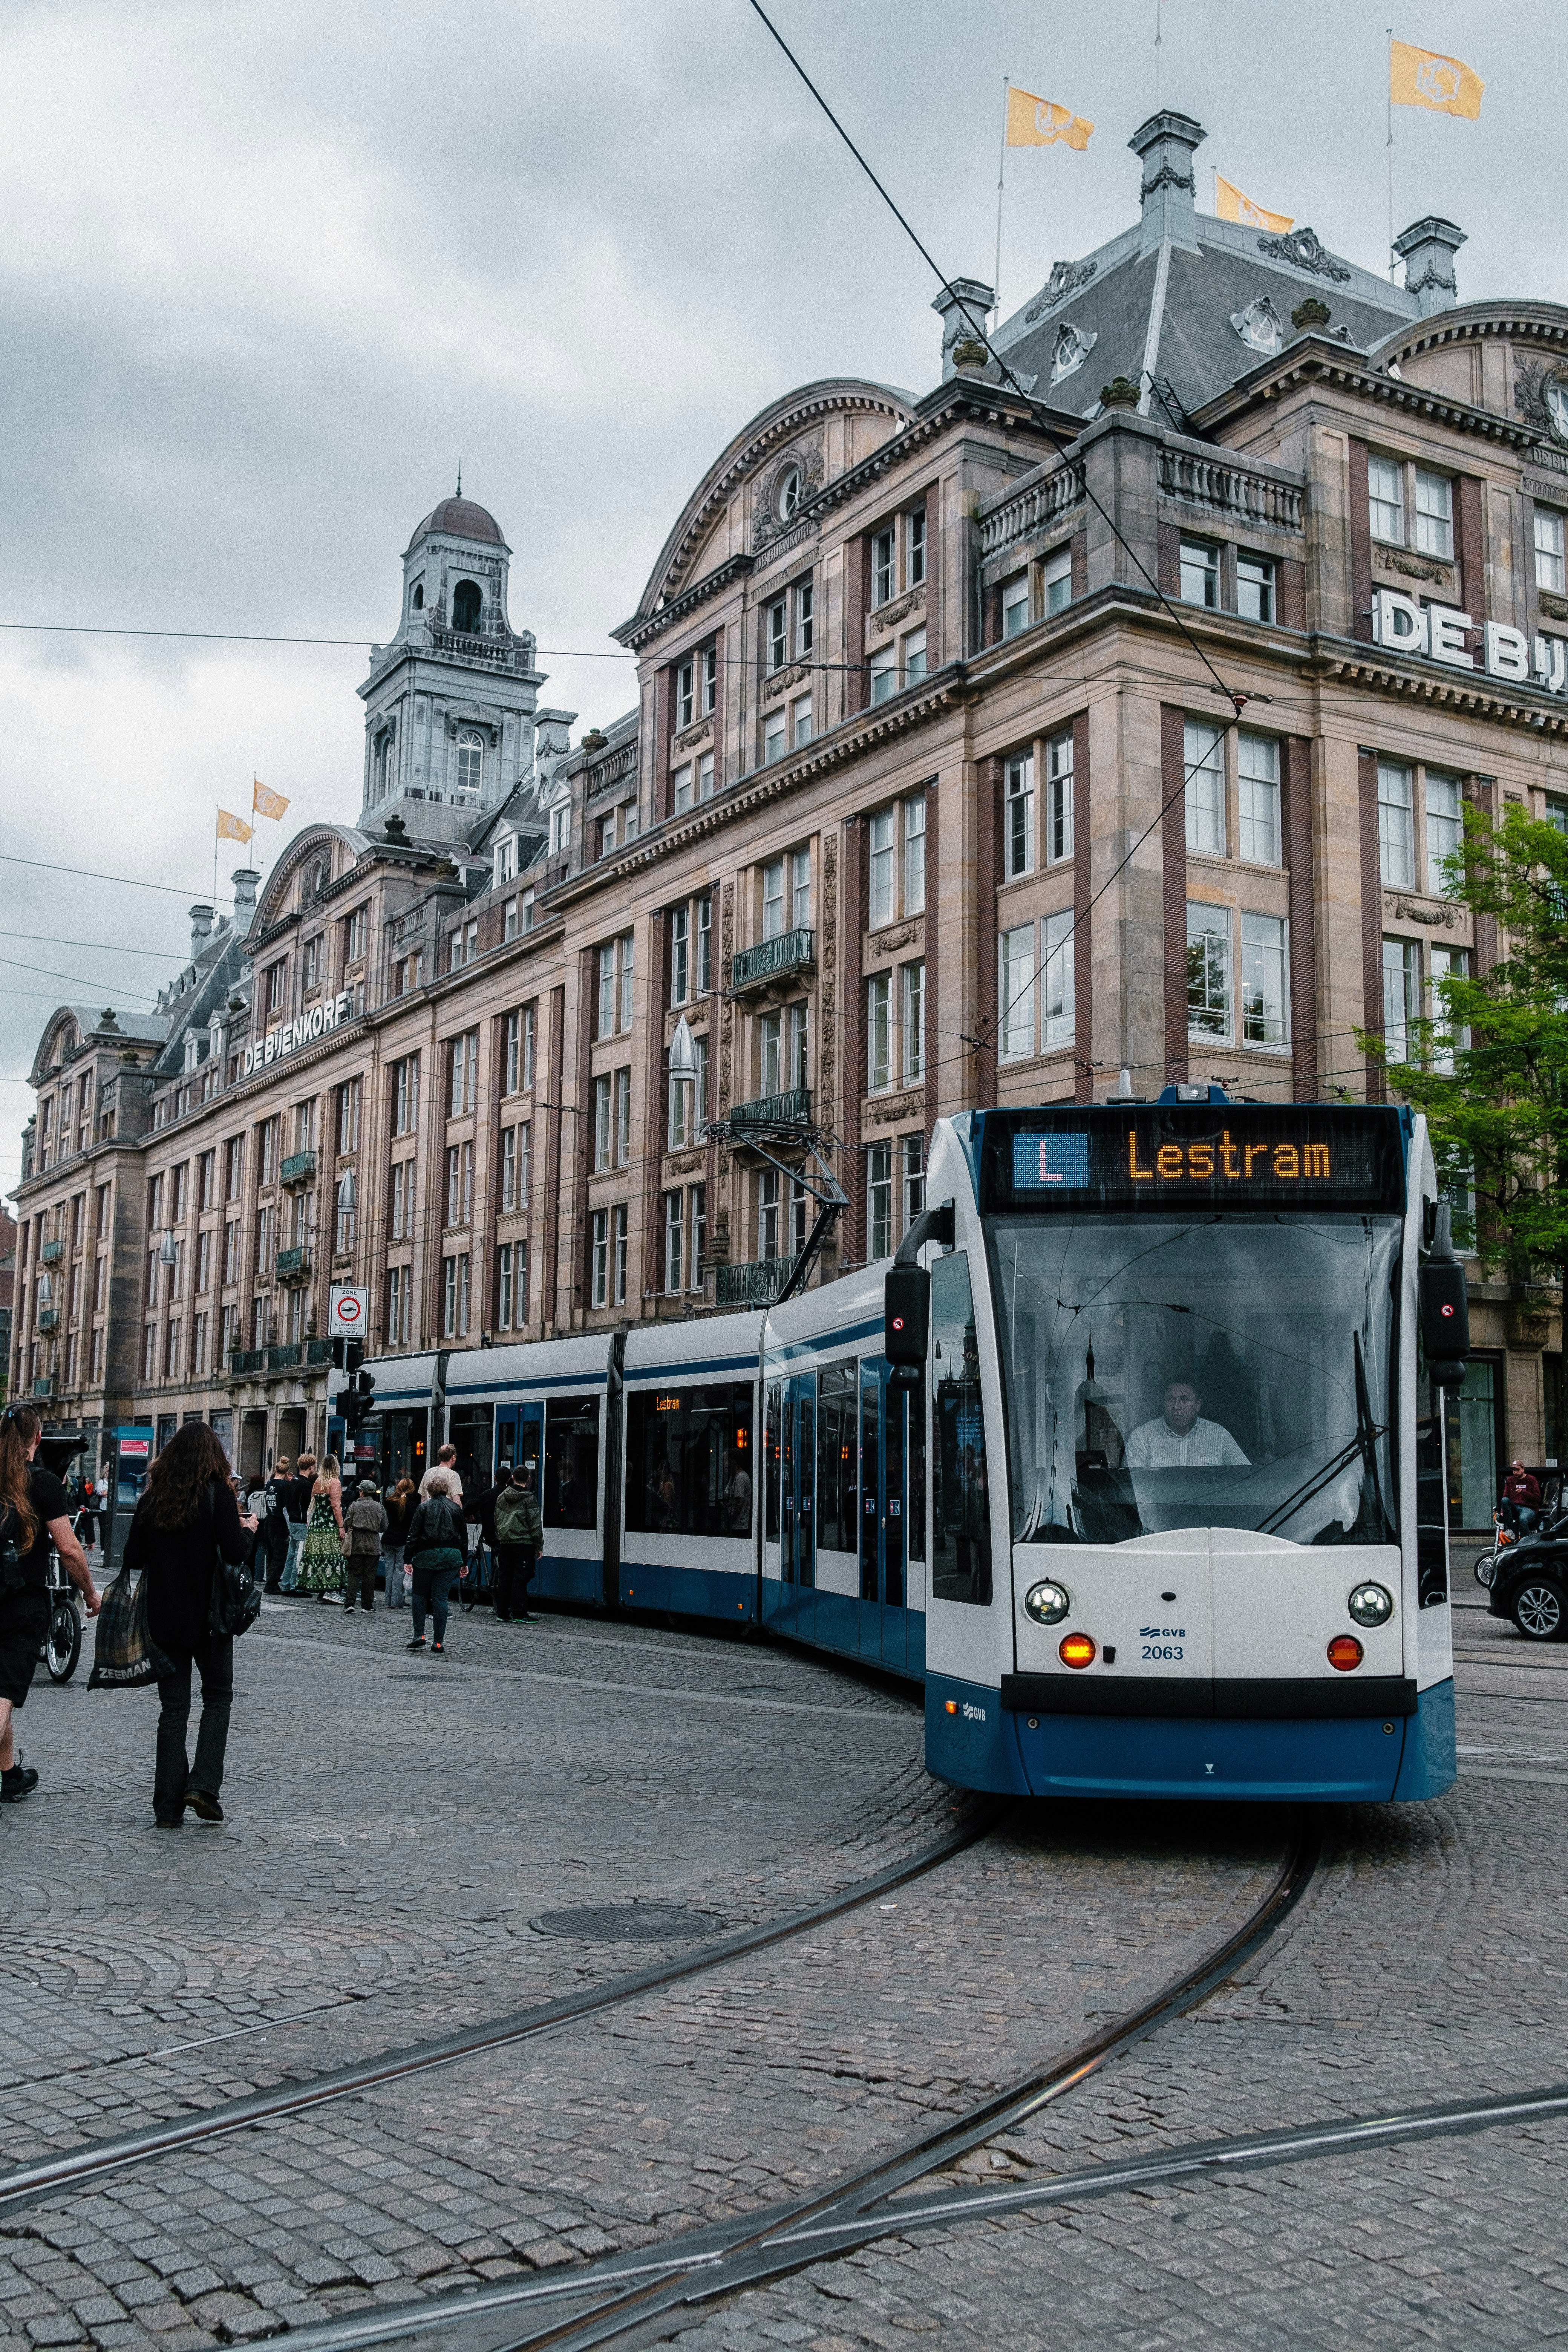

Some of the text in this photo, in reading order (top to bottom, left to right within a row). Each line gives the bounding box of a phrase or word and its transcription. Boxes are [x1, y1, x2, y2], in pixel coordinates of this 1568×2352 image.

[1377, 589, 1565, 691] DE BIJ
[264, 990, 349, 1064] BIJENKORF
[1040, 1131, 1331, 1181] L Lestram
[657, 1396, 679, 1410] Lestram
[1162, 1629, 1186, 1637] GVB
[1141, 1646, 1184, 1660] 2063
[99, 1658, 151, 1680] ZEEMAN
[974, 1707, 985, 1721] GVB
